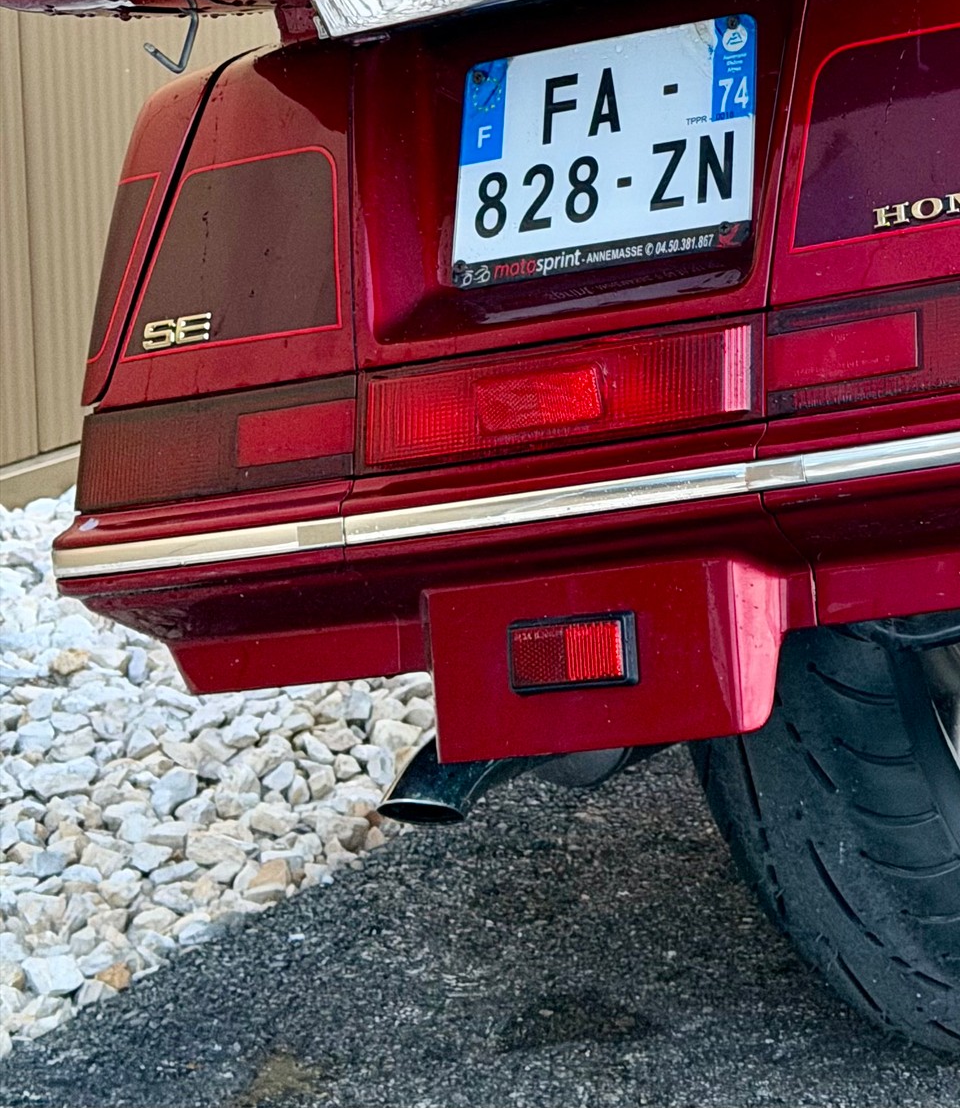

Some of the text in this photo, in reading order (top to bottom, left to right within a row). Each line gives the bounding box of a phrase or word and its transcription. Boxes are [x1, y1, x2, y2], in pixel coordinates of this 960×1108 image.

[542, 67, 621, 146] FA
[719, 76, 749, 112] 74
[686, 115, 707, 125] TPPR
[477, 125, 492, 149] F
[586, 245, 643, 264] ANNEMASSE
[143, 312, 211, 350] SE
